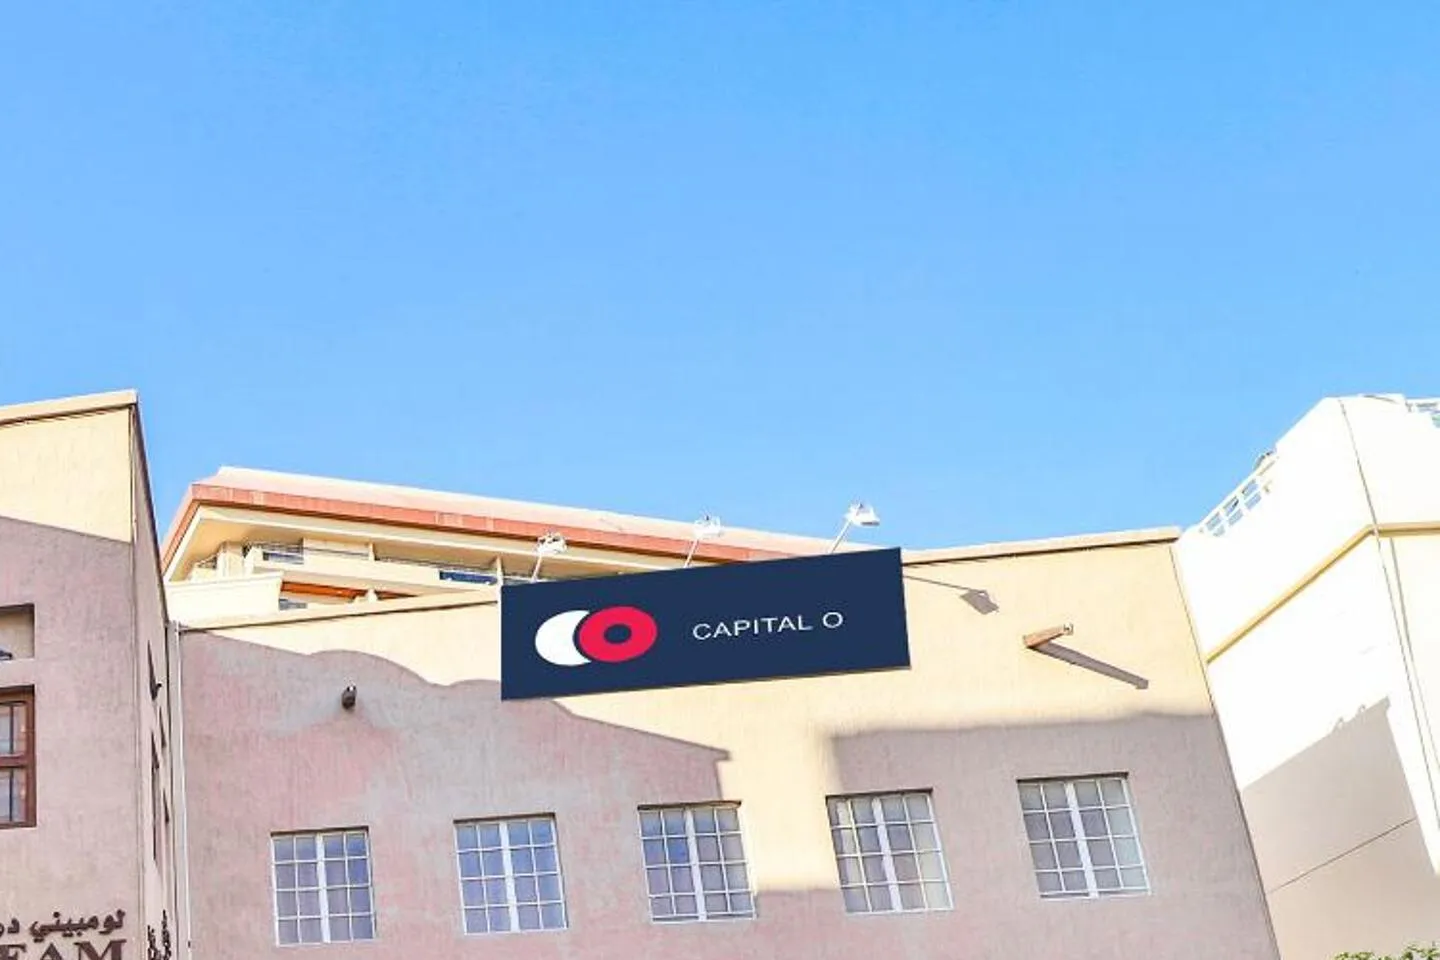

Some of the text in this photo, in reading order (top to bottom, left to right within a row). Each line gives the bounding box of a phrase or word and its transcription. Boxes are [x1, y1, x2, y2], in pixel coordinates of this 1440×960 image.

[692, 612, 844, 640] CAPITAL O
[29, 908, 126, 943] لومبيني
